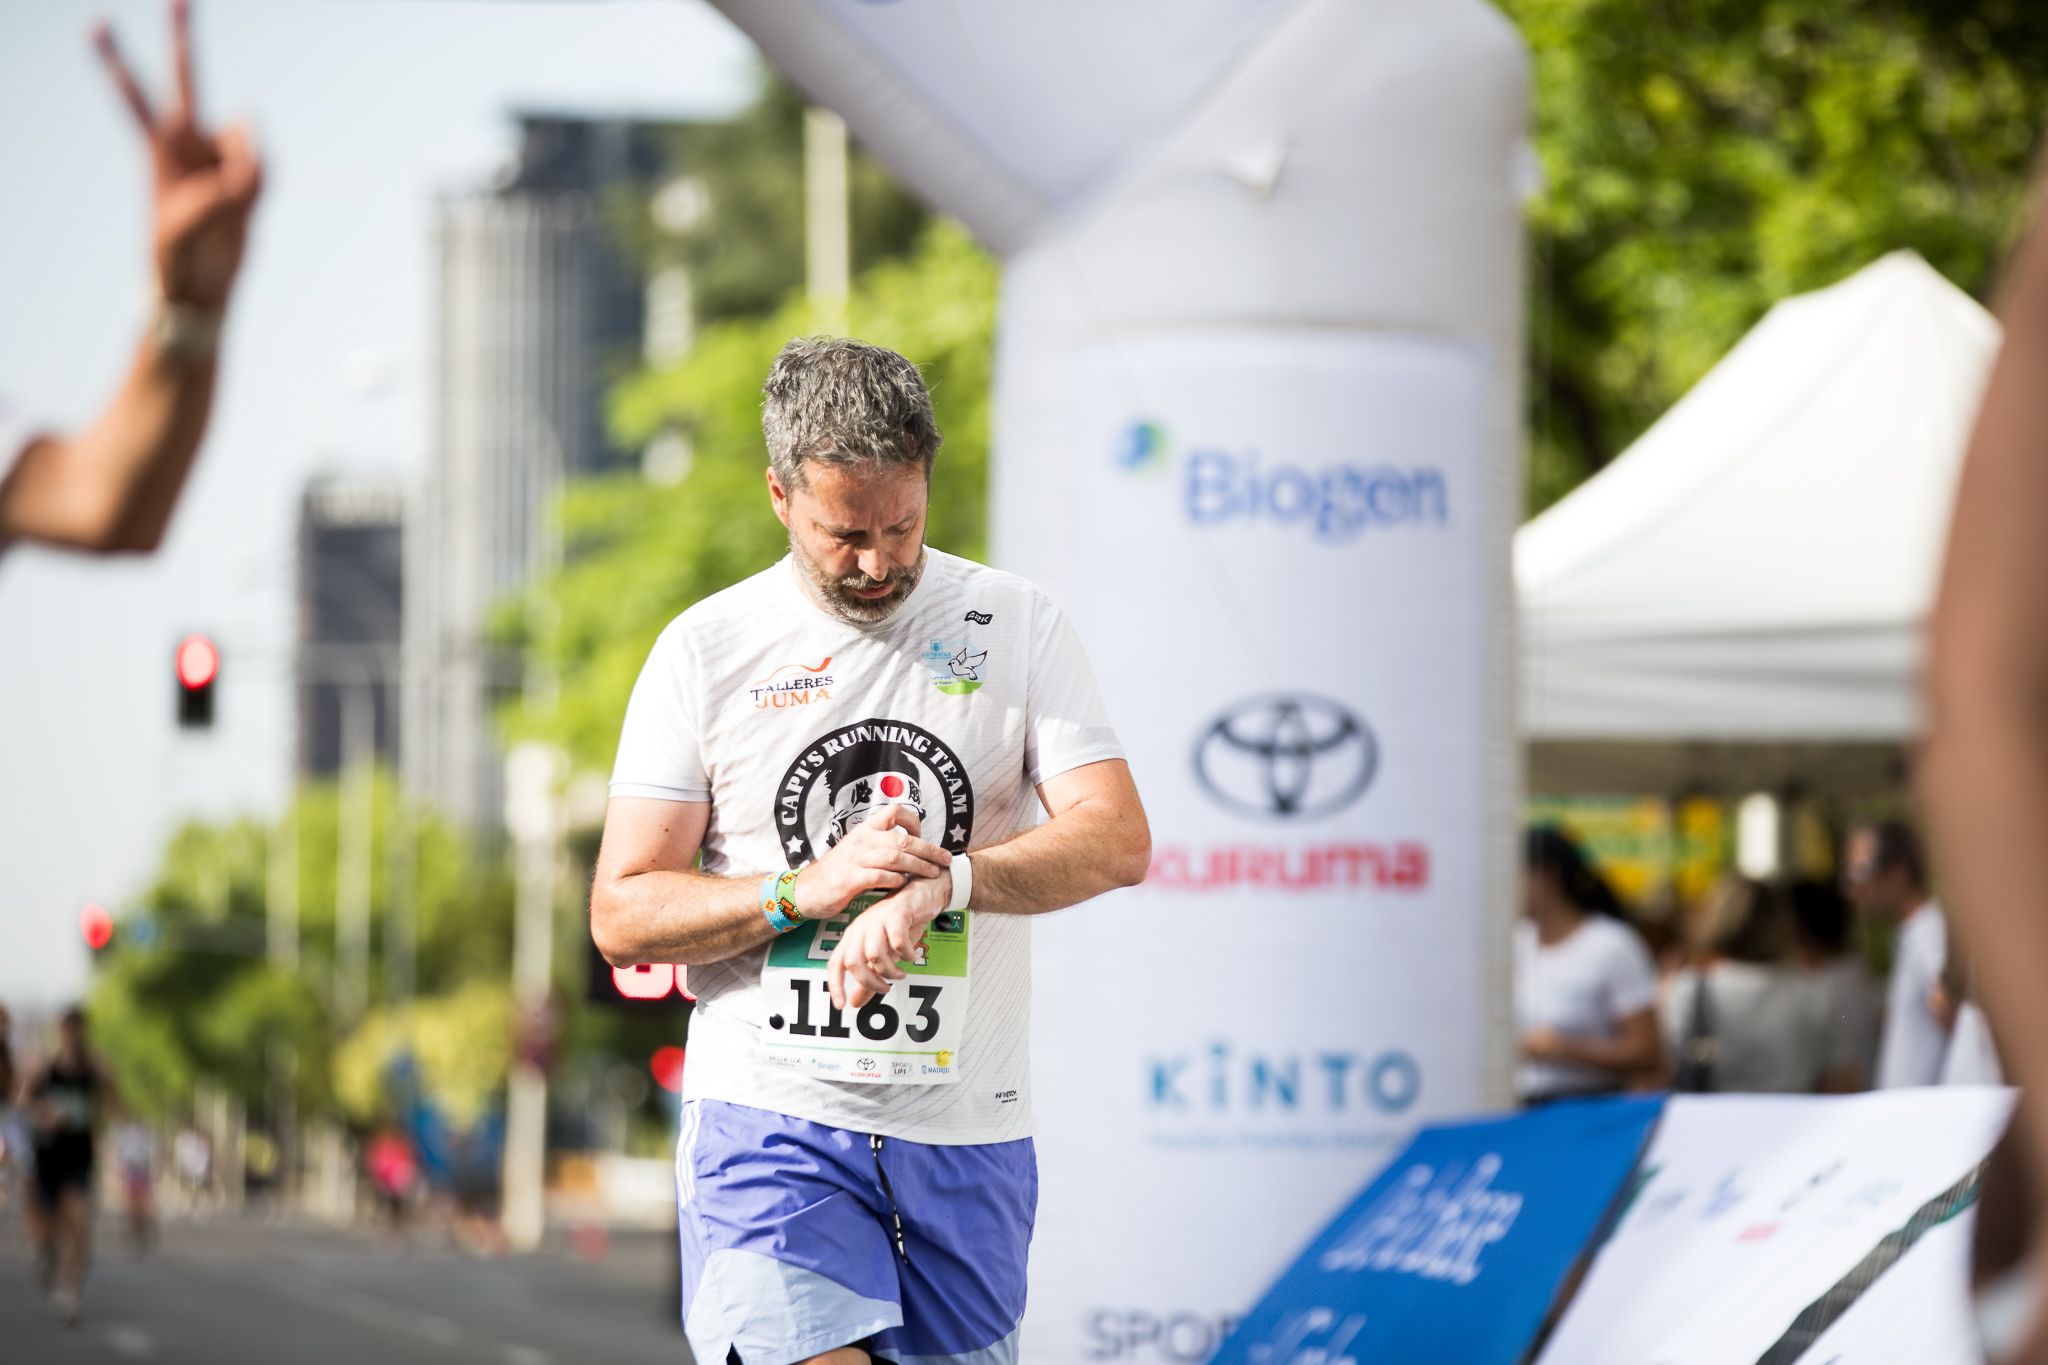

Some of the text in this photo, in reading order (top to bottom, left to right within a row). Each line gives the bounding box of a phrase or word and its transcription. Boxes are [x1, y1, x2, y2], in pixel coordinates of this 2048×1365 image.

[1184, 448, 1447, 543] Biogen
[750, 675, 834, 702] TALLERES
[755, 688, 832, 709] JUMA
[781, 750, 825, 826] CAPI'S
[822, 726, 931, 757] RUNNING
[928, 747, 968, 814] TEAM
[927, 1067, 950, 1075] MADRID
